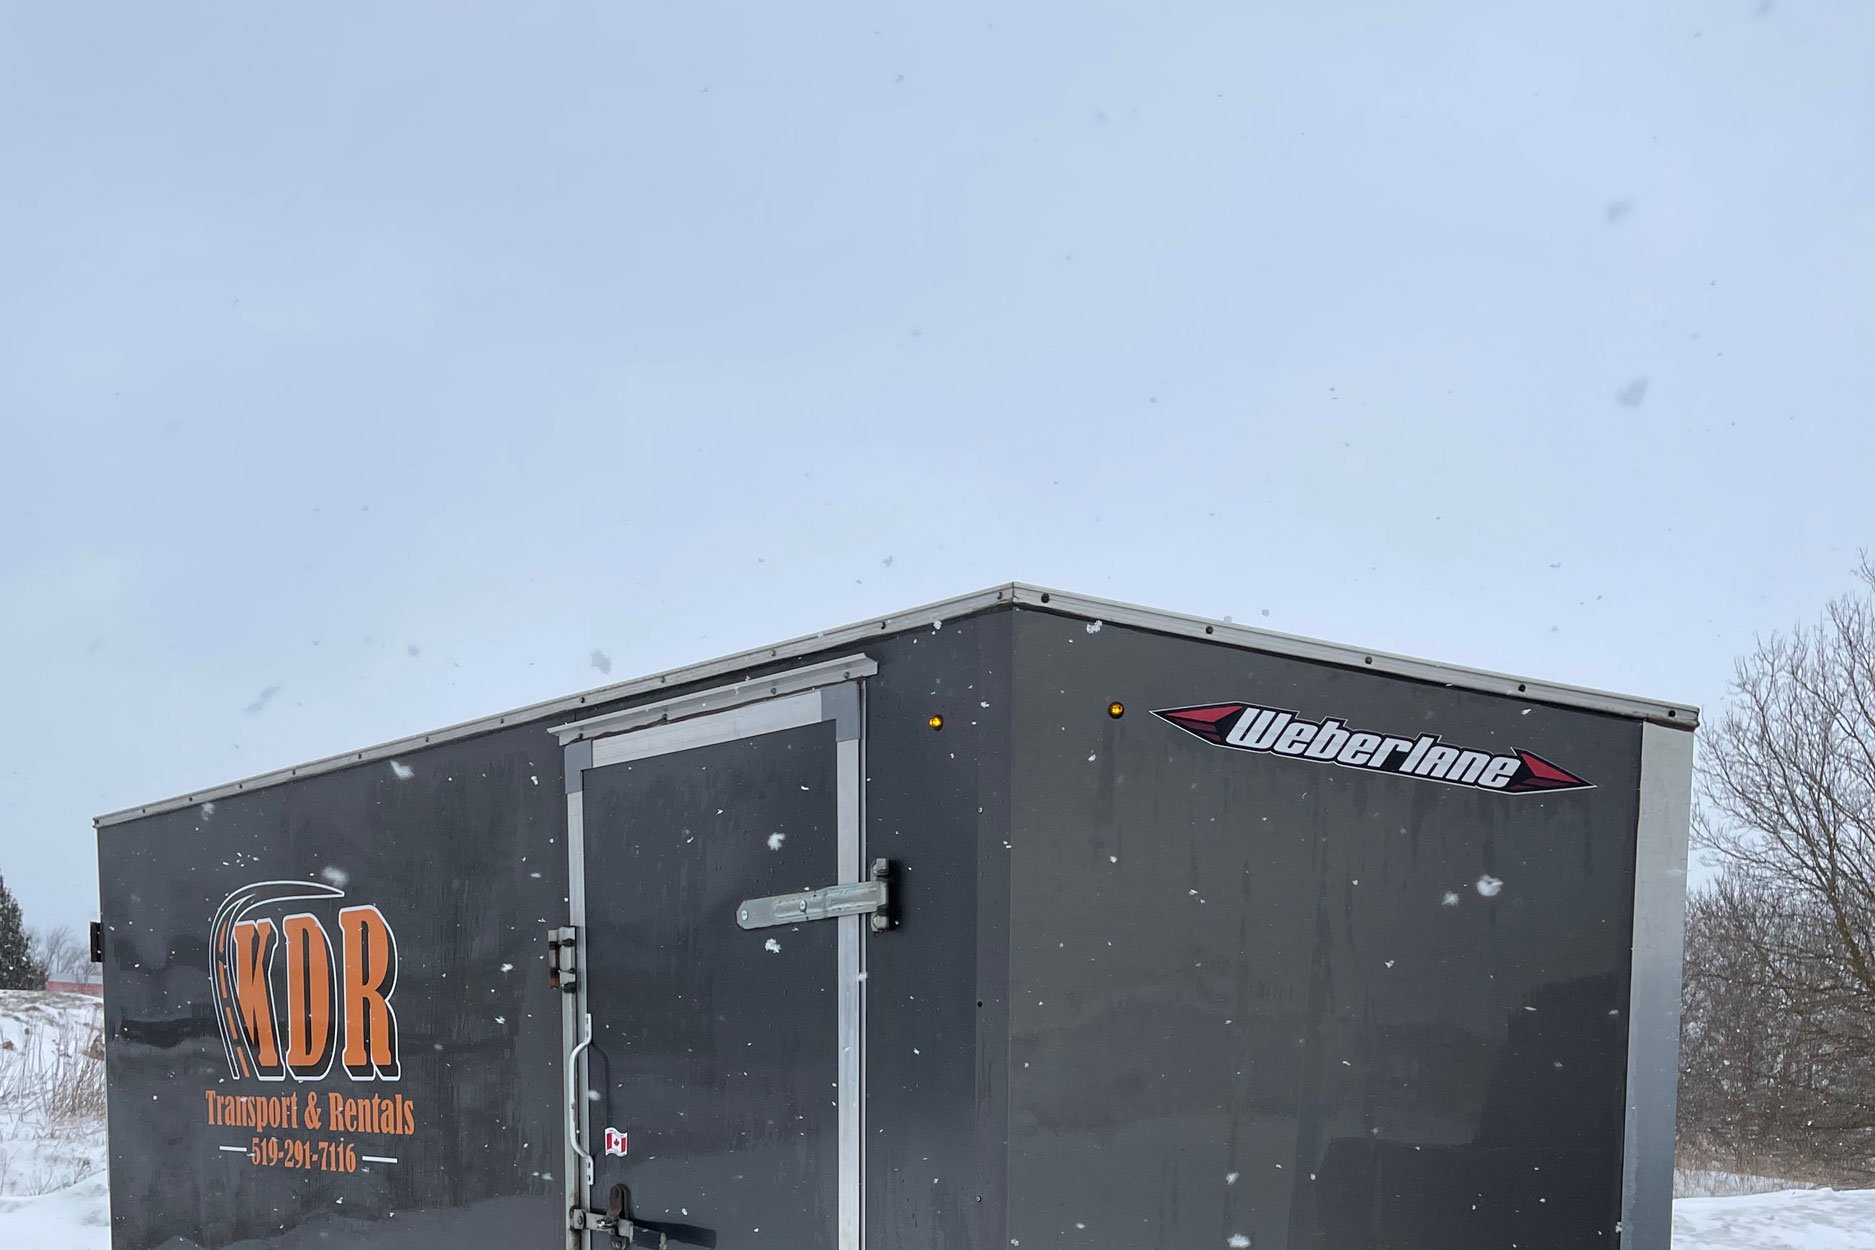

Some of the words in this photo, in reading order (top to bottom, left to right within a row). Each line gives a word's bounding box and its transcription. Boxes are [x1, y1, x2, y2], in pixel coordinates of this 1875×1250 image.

[1225, 706, 1522, 788] Weberlane
[233, 904, 401, 1081] KDR
[205, 1089, 299, 1133] Transport
[304, 1090, 322, 1131] &
[328, 1091, 415, 1136] Rentals
[251, 1136, 357, 1174] 519-291-7116
